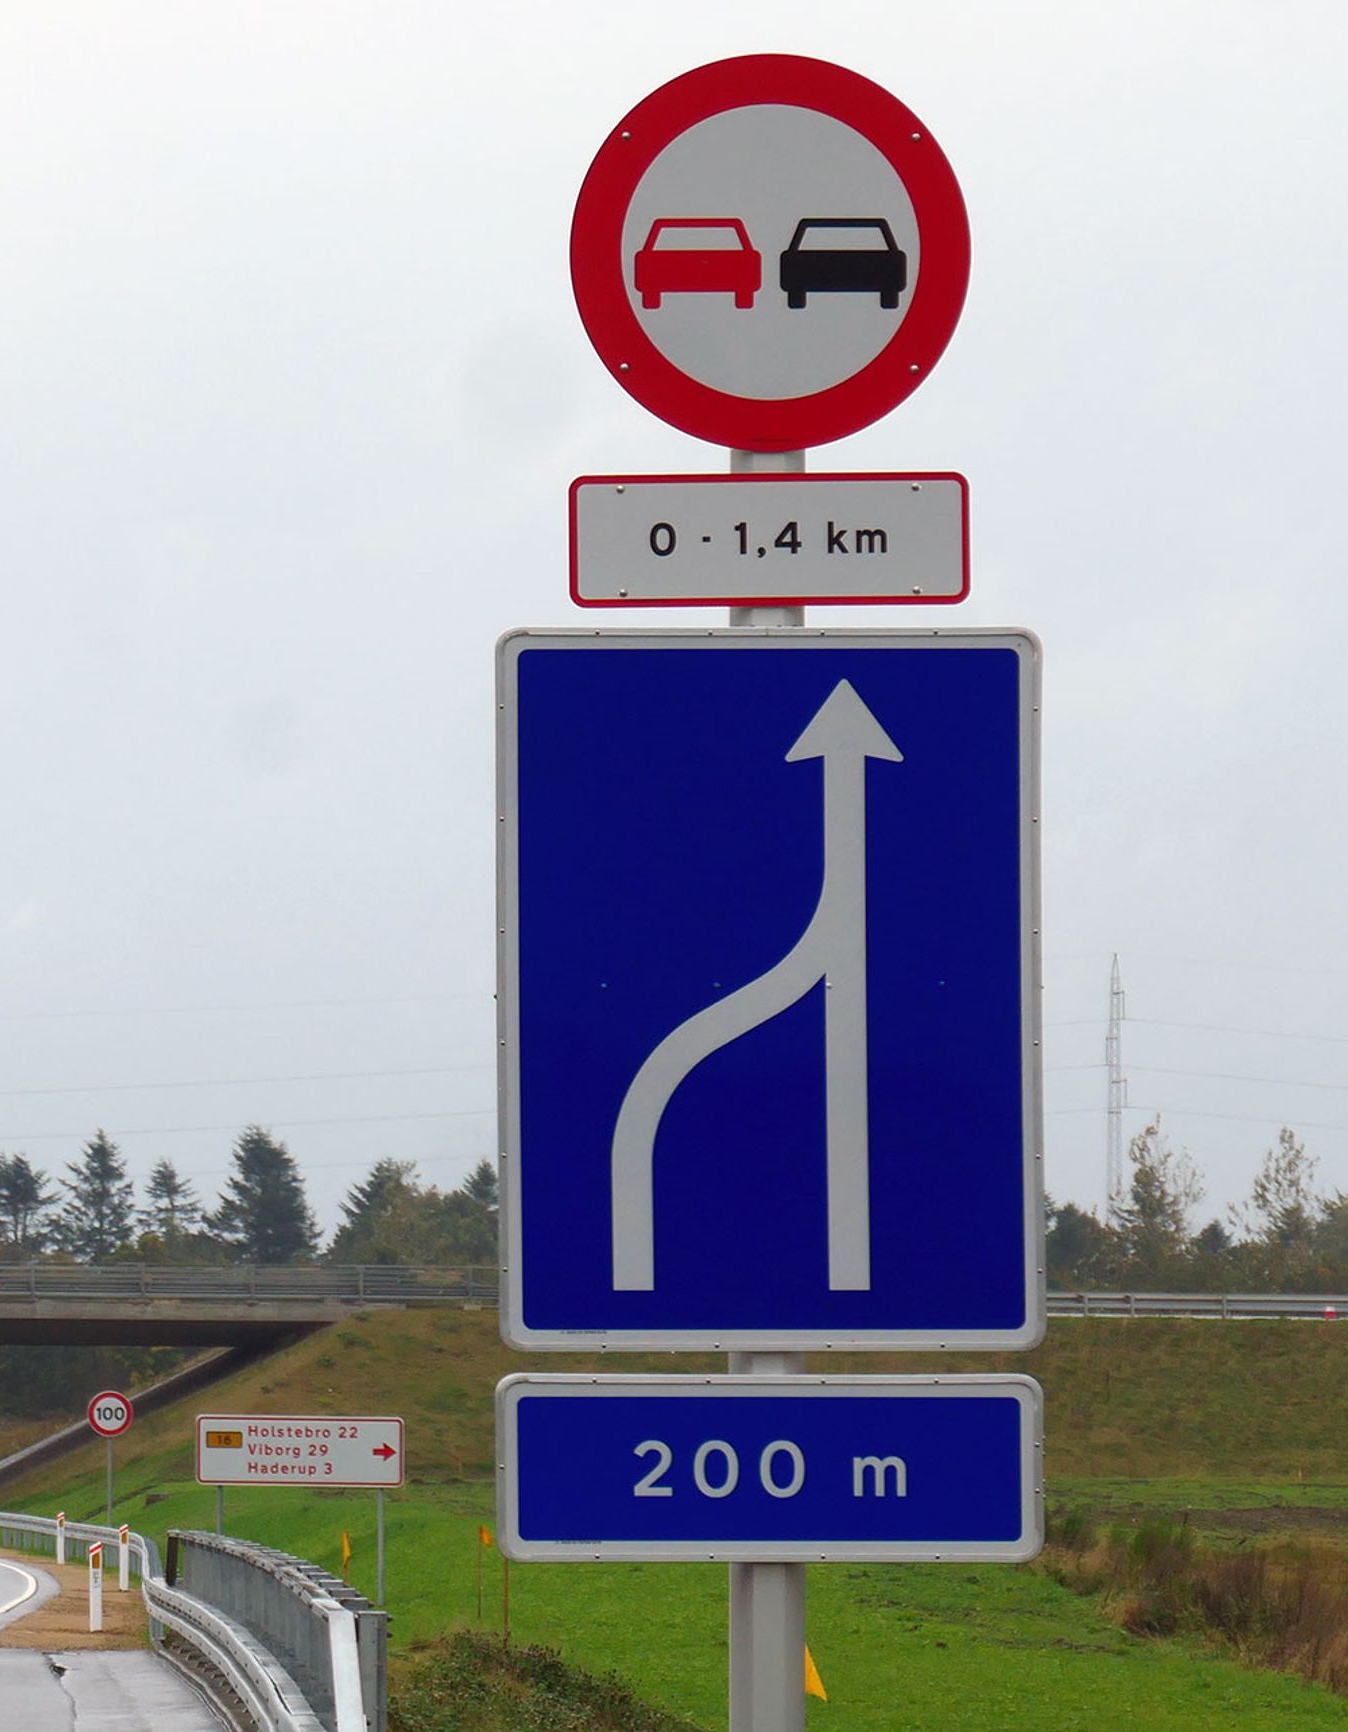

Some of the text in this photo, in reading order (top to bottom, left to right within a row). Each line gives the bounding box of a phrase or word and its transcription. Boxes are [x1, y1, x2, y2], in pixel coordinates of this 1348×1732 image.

[649, 521, 677, 557] 0
[734, 521, 802, 558] 1,4
[827, 521, 888, 554] km
[96, 1407, 125, 1421] 100
[248, 1425, 358, 1439] Holstebro 22
[217, 1435, 232, 1446] 16
[248, 1443, 329, 1459] Viborg 29
[248, 1462, 333, 1477] Haderup 3
[632, 1439, 907, 1498] 200 m
